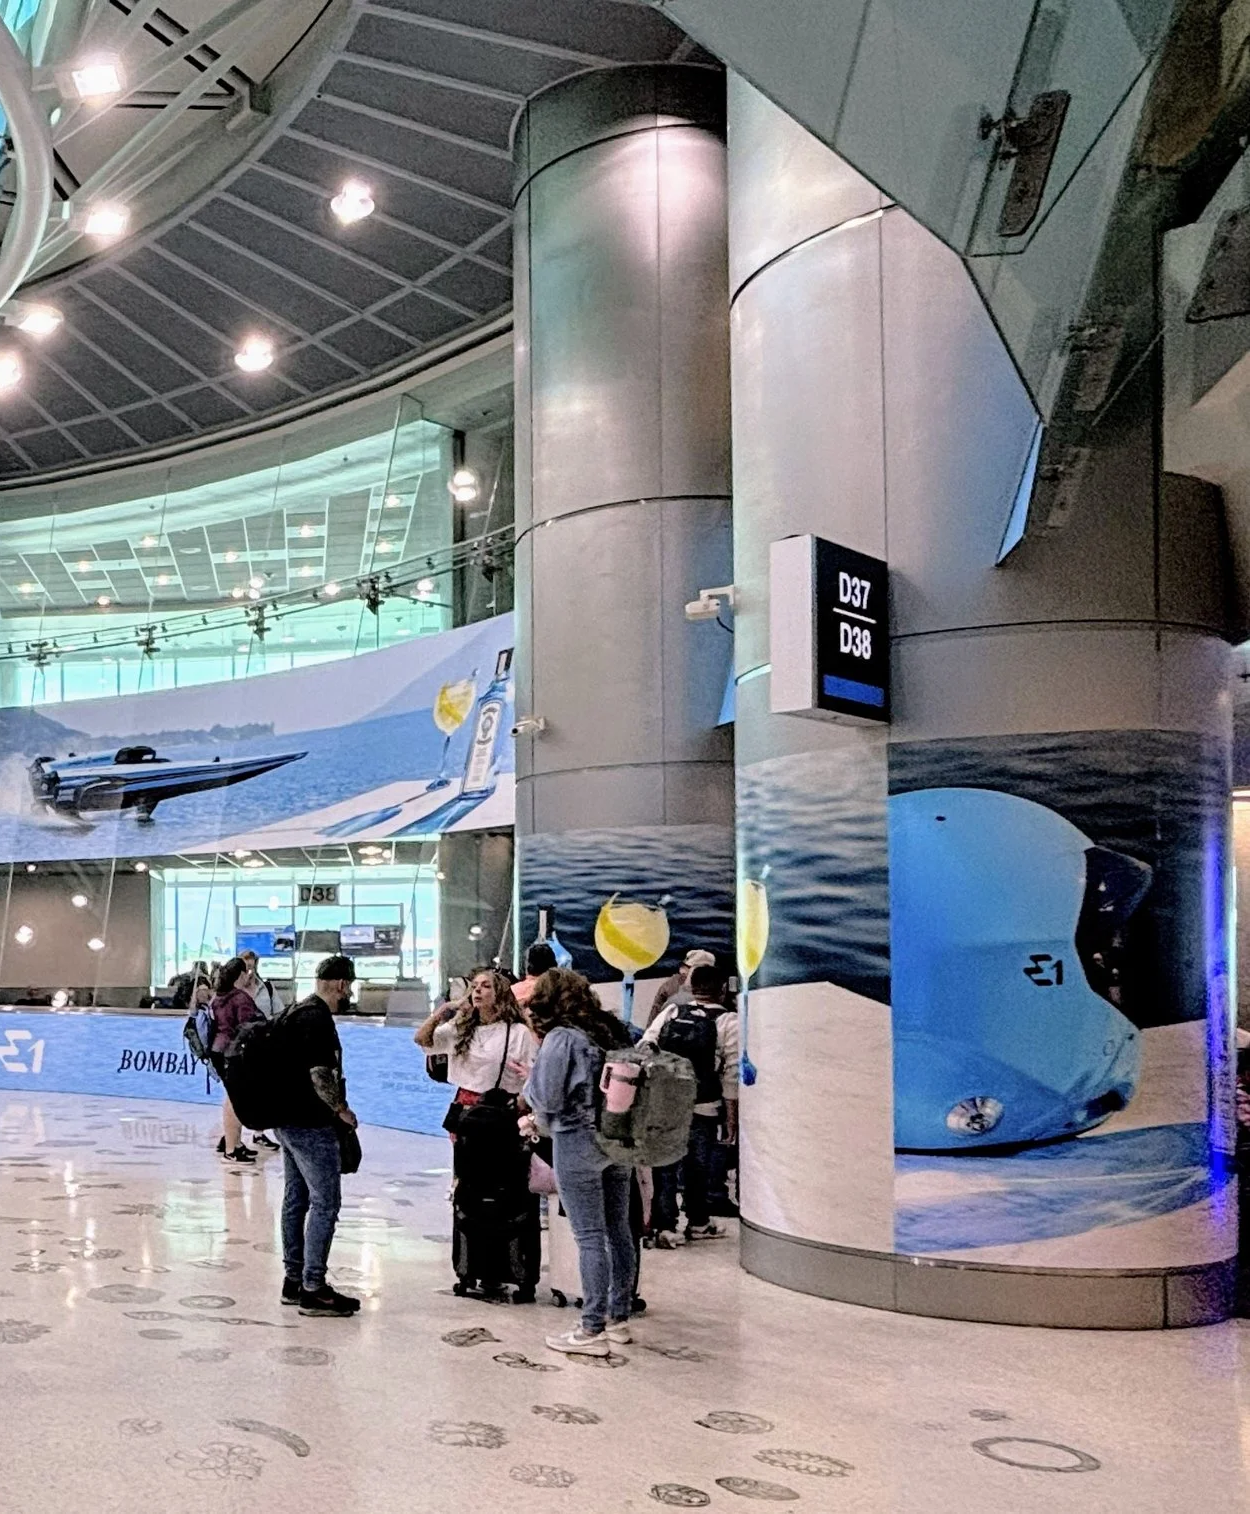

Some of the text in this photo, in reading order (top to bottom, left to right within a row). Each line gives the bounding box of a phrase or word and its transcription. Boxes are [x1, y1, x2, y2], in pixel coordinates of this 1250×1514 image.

[838, 571, 871, 610] D37
[839, 621, 872, 660] D38
[117, 1049, 199, 1075] BOMBAY
